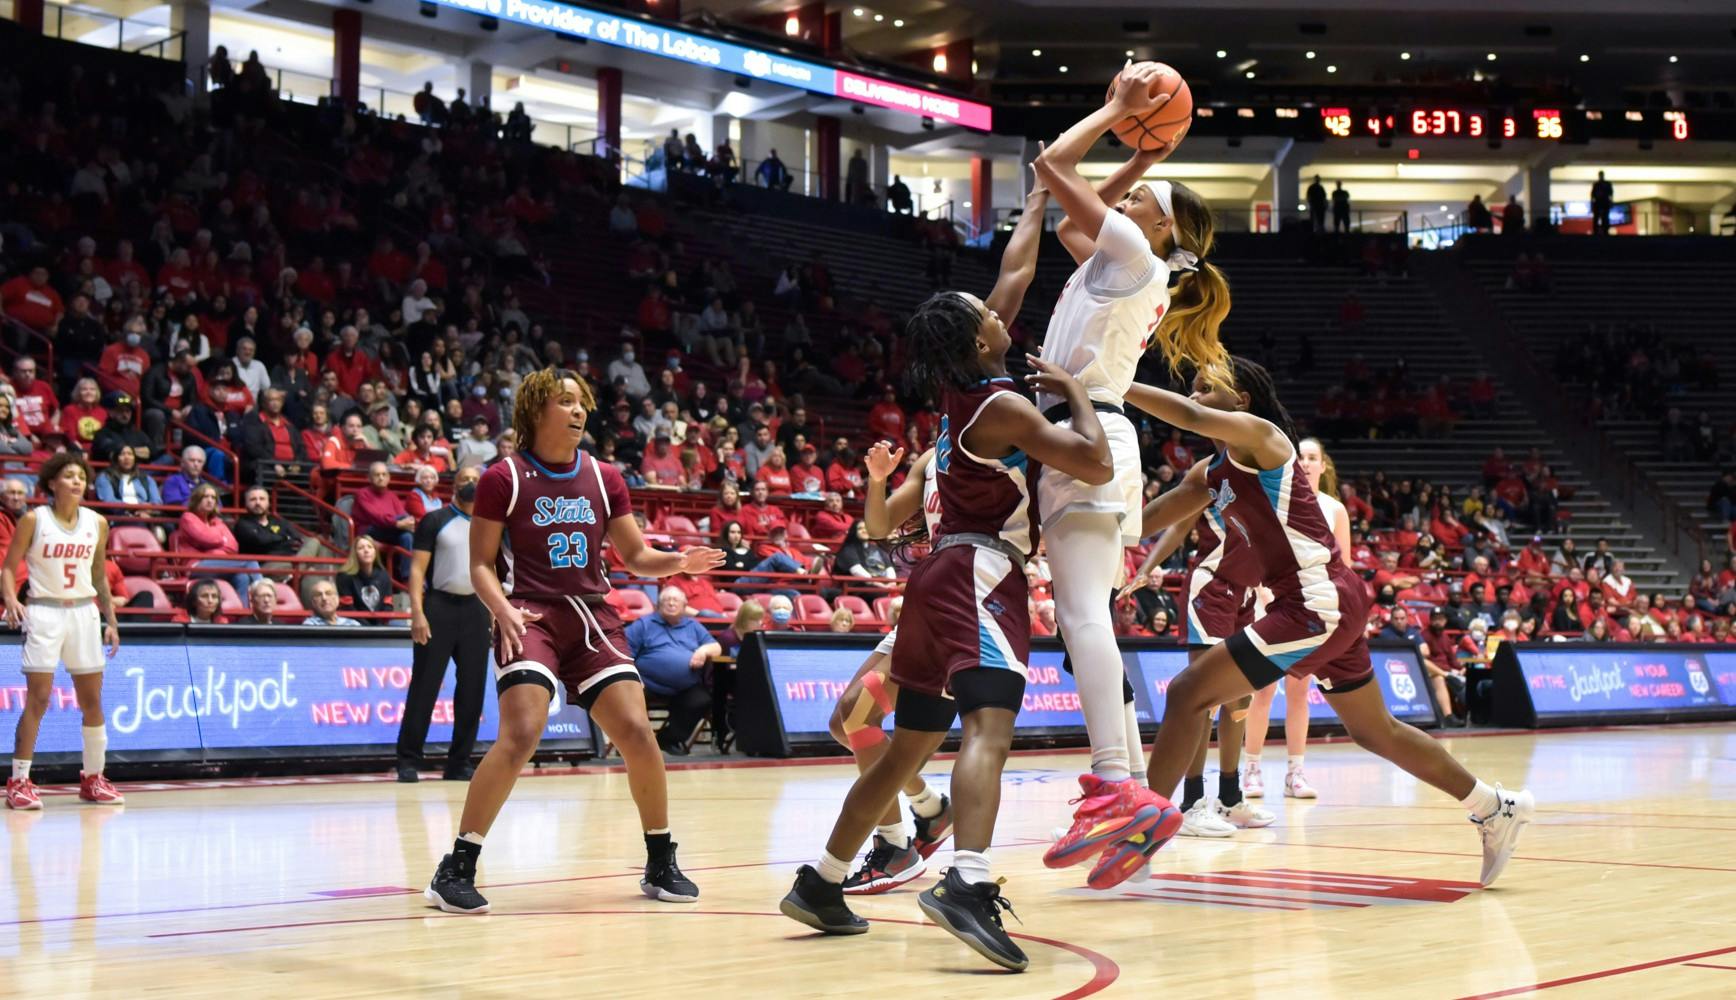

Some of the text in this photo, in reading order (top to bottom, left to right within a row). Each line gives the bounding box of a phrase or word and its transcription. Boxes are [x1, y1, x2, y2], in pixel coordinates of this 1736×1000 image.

[506, 0, 593, 34] Provider
[597, 19, 620, 40] of
[623, 22, 659, 50] The
[663, 32, 721, 64] Lobos
[843, 77, 921, 109] DELIVERING
[1325, 110, 1688, 139] 42 4 6:37 3 3 36 0
[532, 496, 596, 526] State
[43, 543, 92, 559] LOBOS
[548, 532, 588, 568] 23
[63, 563, 77, 589] 5
[342, 667, 369, 688] IN
[786, 681, 816, 700] HIT
[1396, 678, 1413, 694] 66
[1569, 661, 1624, 702] Jackpot
[112, 661, 298, 733] Jackpot
[312, 702, 370, 724] NEW
[548, 723, 581, 734] HOTEL
